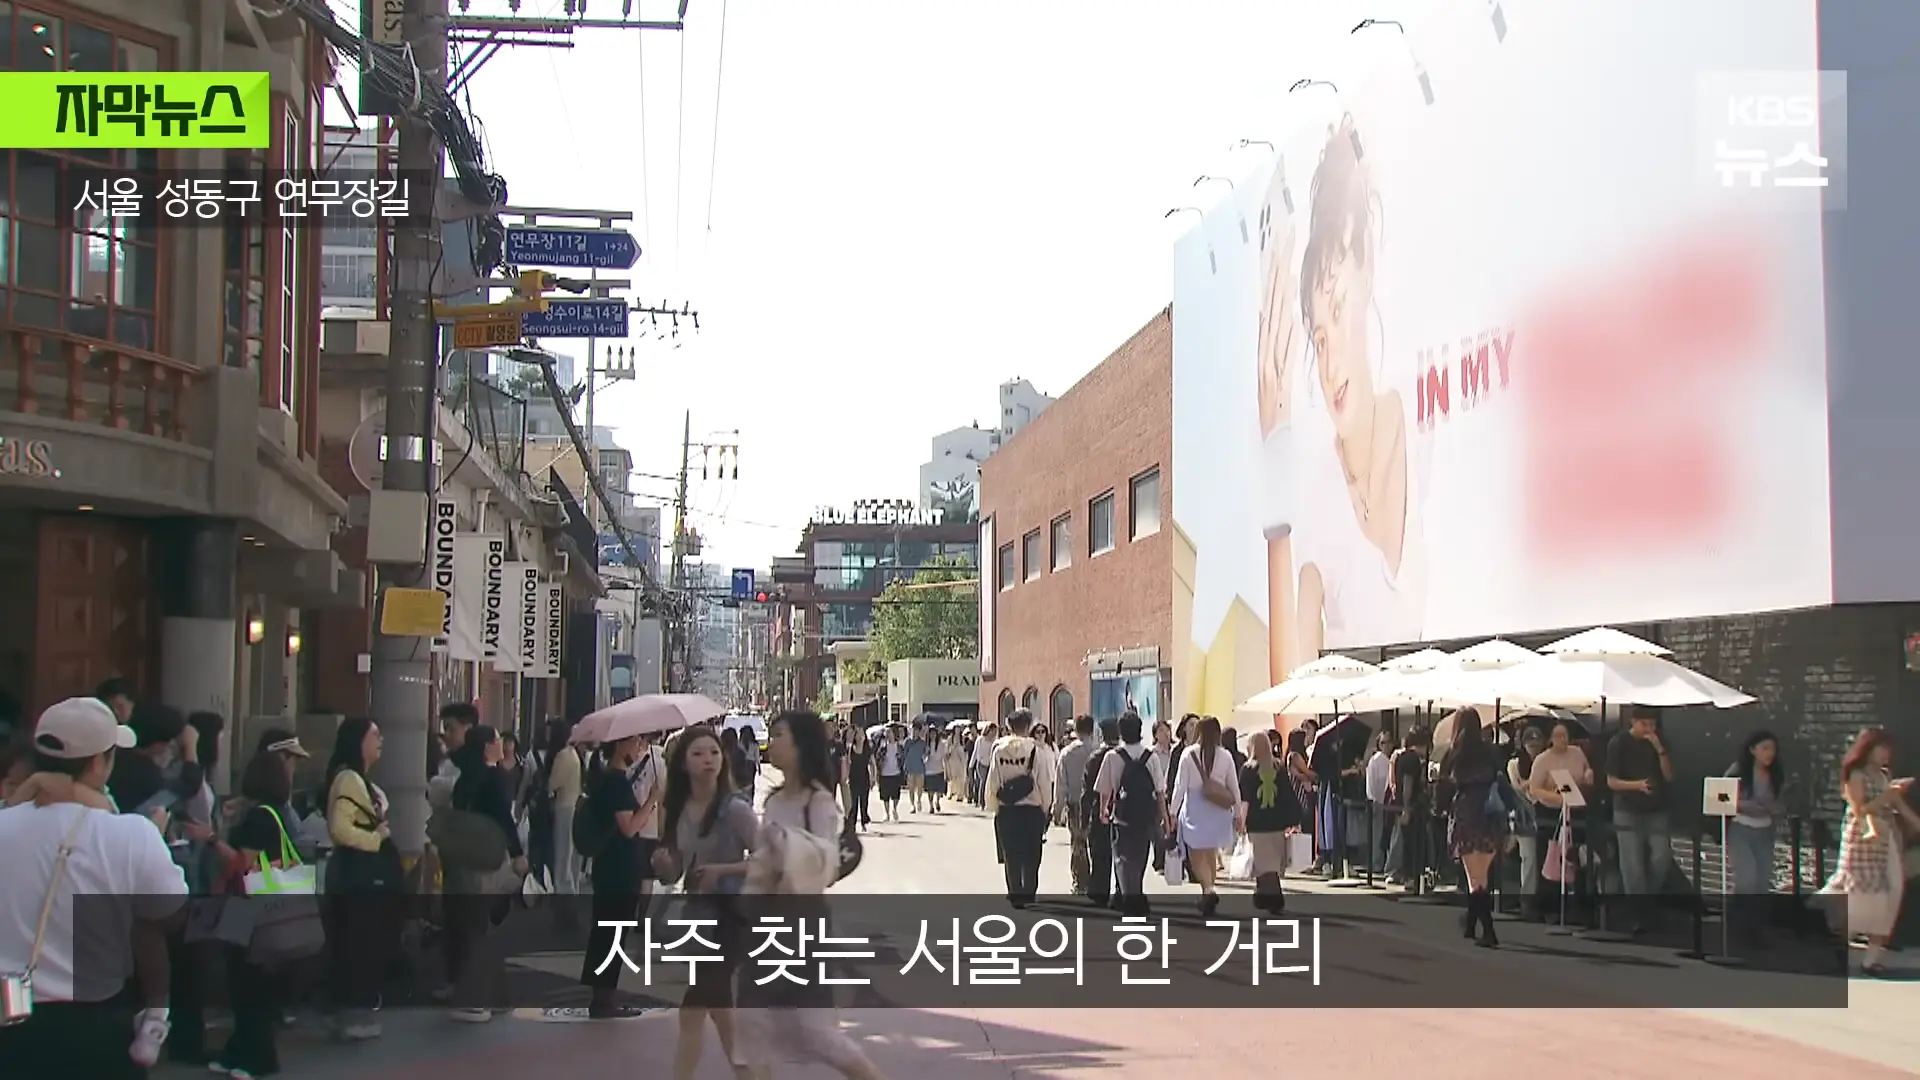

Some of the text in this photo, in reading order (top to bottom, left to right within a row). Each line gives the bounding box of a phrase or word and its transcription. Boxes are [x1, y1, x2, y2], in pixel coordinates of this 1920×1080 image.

[510, 232, 587, 252] 연무장11길
[510, 250, 614, 266] Yeonmujang 11-gil
[457, 325, 483, 345] CCTV
[521, 322, 624, 335] Seongsui-ro 14-gil
[1416, 329, 1515, 430] IN MY
[812, 506, 944, 525] BLUE ELEPHANT
[484, 540, 503, 649] BOUNDARY
[522, 568, 538, 663] BOUNDARY
[548, 588, 560, 668] BOUNDARY
